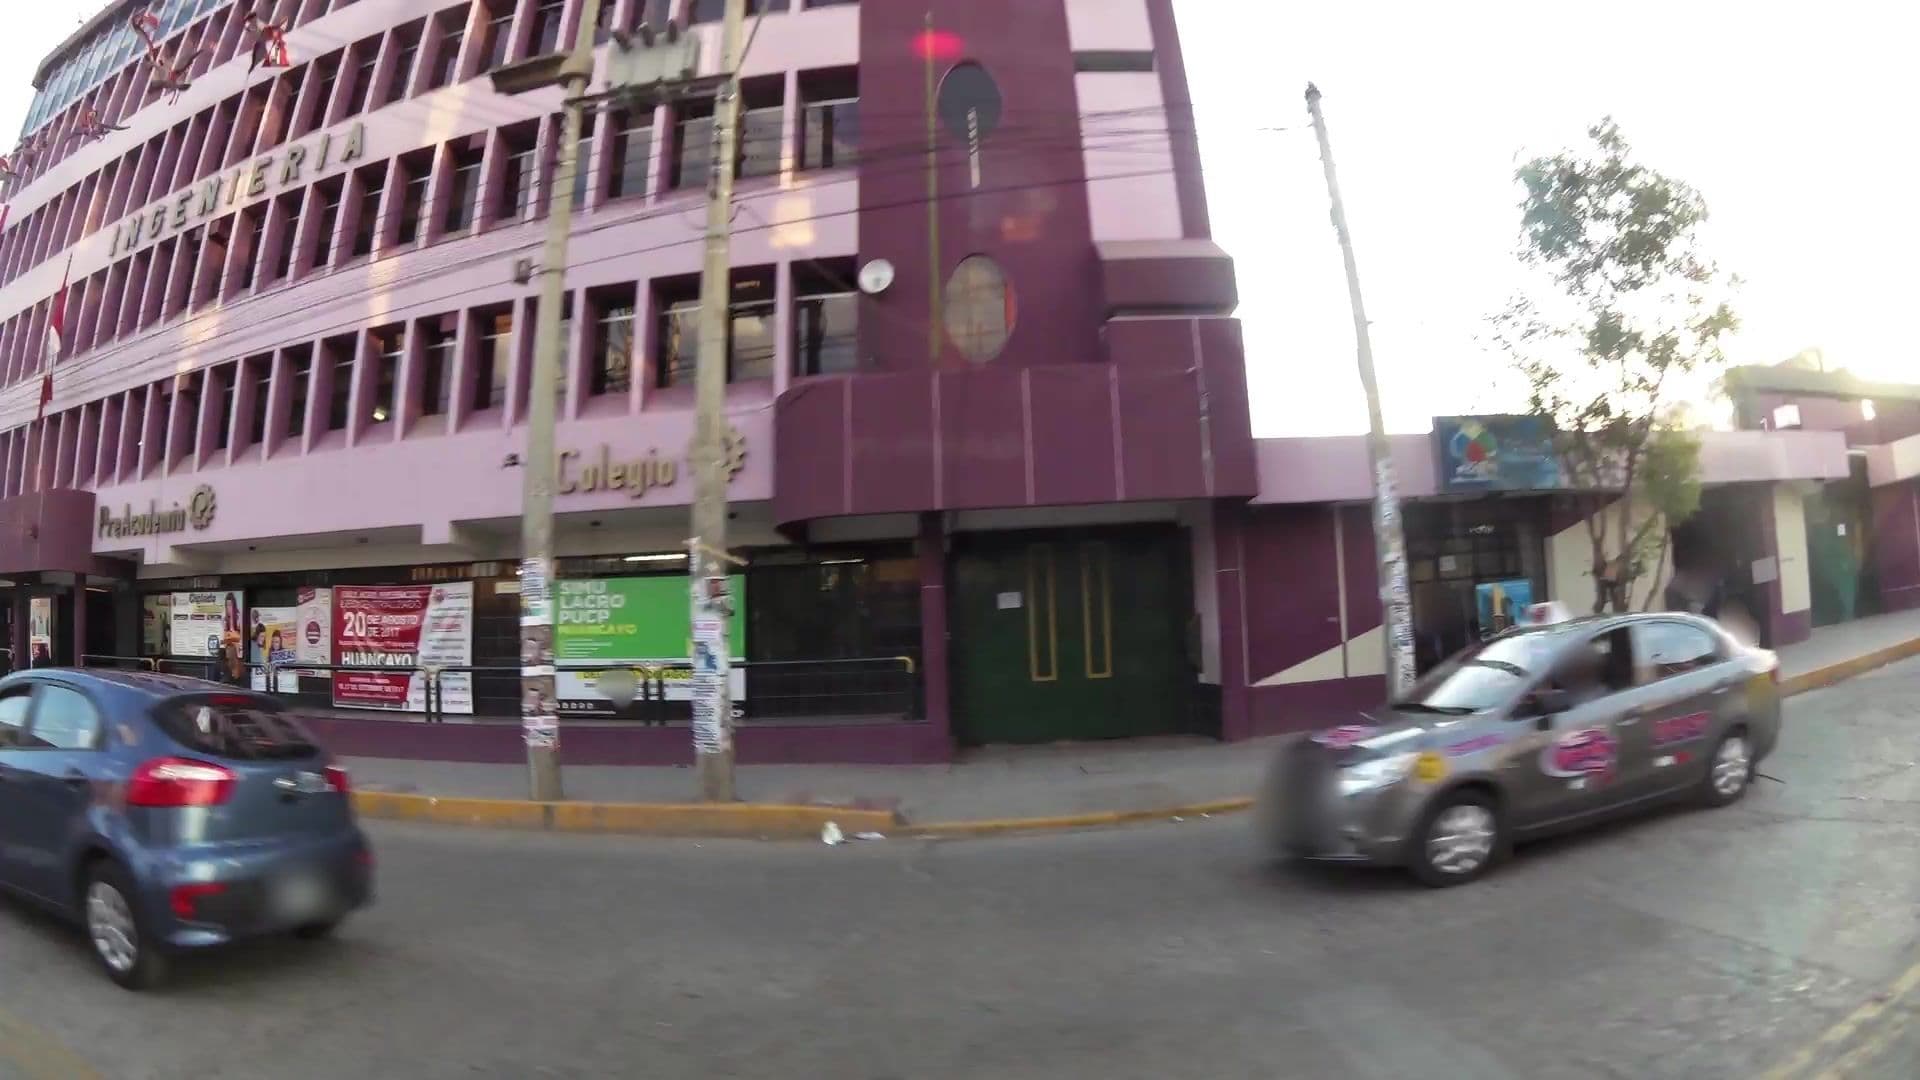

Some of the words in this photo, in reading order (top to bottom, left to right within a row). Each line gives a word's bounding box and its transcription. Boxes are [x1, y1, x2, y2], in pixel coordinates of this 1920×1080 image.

[109, 122, 365, 257] INGENIERIA
[556, 444, 676, 498] Colegio
[560, 594, 626, 609] LACRO
[343, 611, 366, 637] 20
[560, 609, 610, 624] PUCP
[342, 652, 411, 666] HUANCAYO
